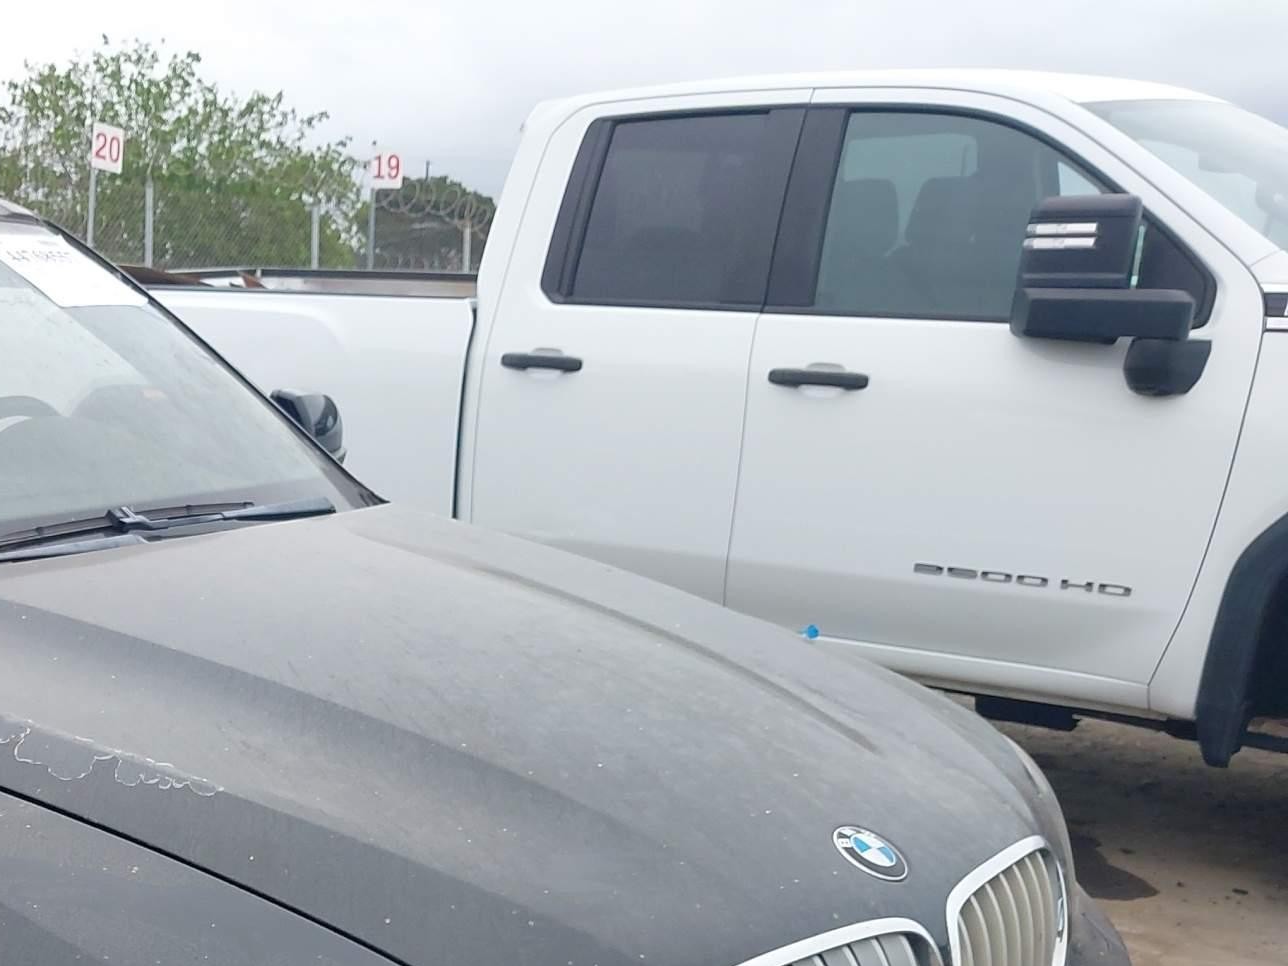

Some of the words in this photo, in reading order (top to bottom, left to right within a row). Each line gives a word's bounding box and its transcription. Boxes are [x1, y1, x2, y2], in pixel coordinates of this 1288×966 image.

[95, 132, 120, 163] 20
[373, 154, 400, 179] 19
[1060, 579, 1133, 597] HD
